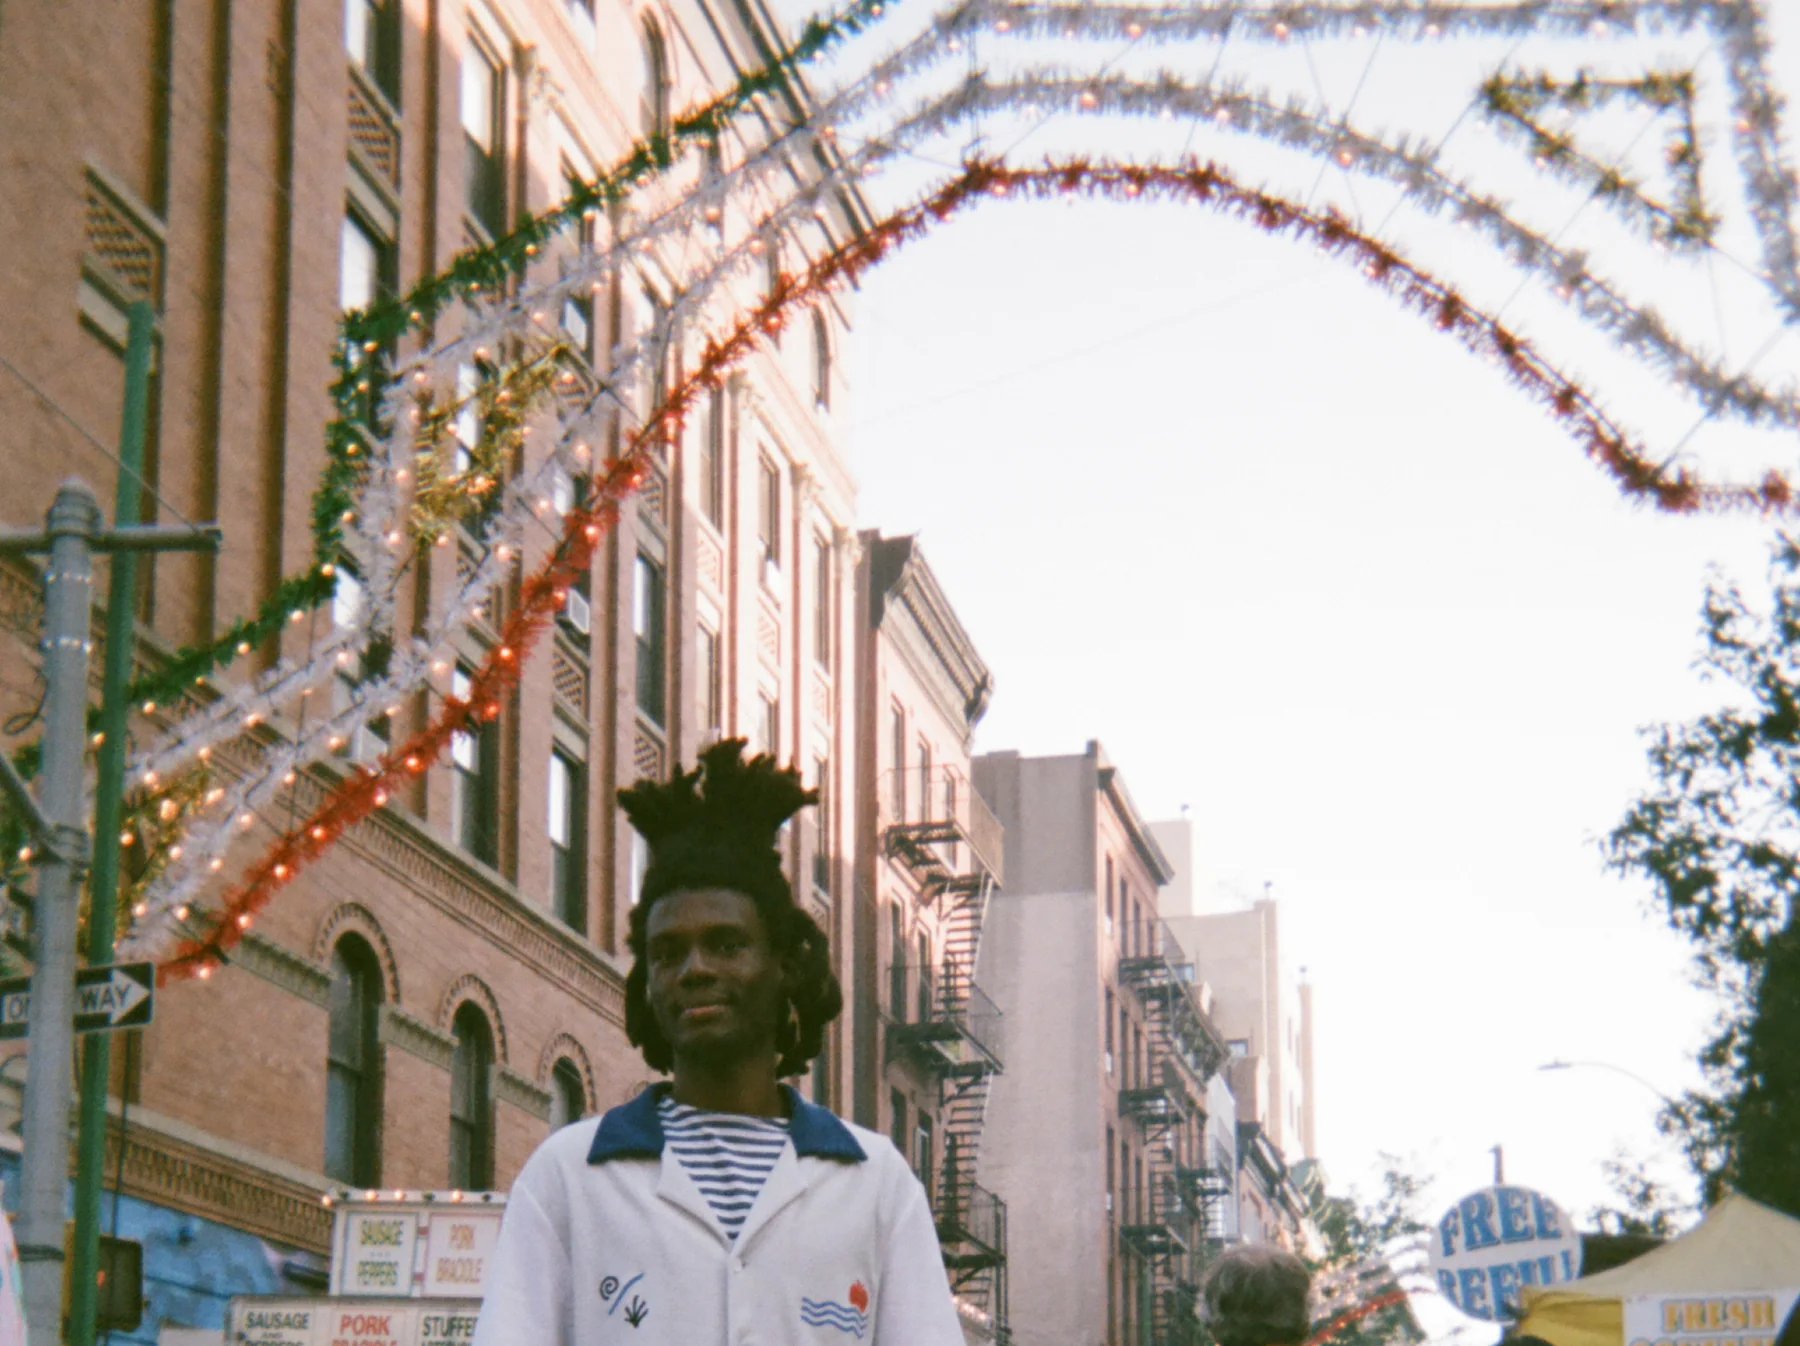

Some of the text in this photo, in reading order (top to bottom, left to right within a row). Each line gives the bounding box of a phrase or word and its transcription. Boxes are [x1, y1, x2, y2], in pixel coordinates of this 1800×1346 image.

[82, 983, 132, 1013] WAY
[1439, 1187, 1561, 1258] FREE
[357, 1260, 398, 1286] PEPPERS
[246, 1312, 309, 1330] SAUSAGE
[340, 1314, 391, 1335] PORK
[1661, 1297, 1775, 1333] FRESH
